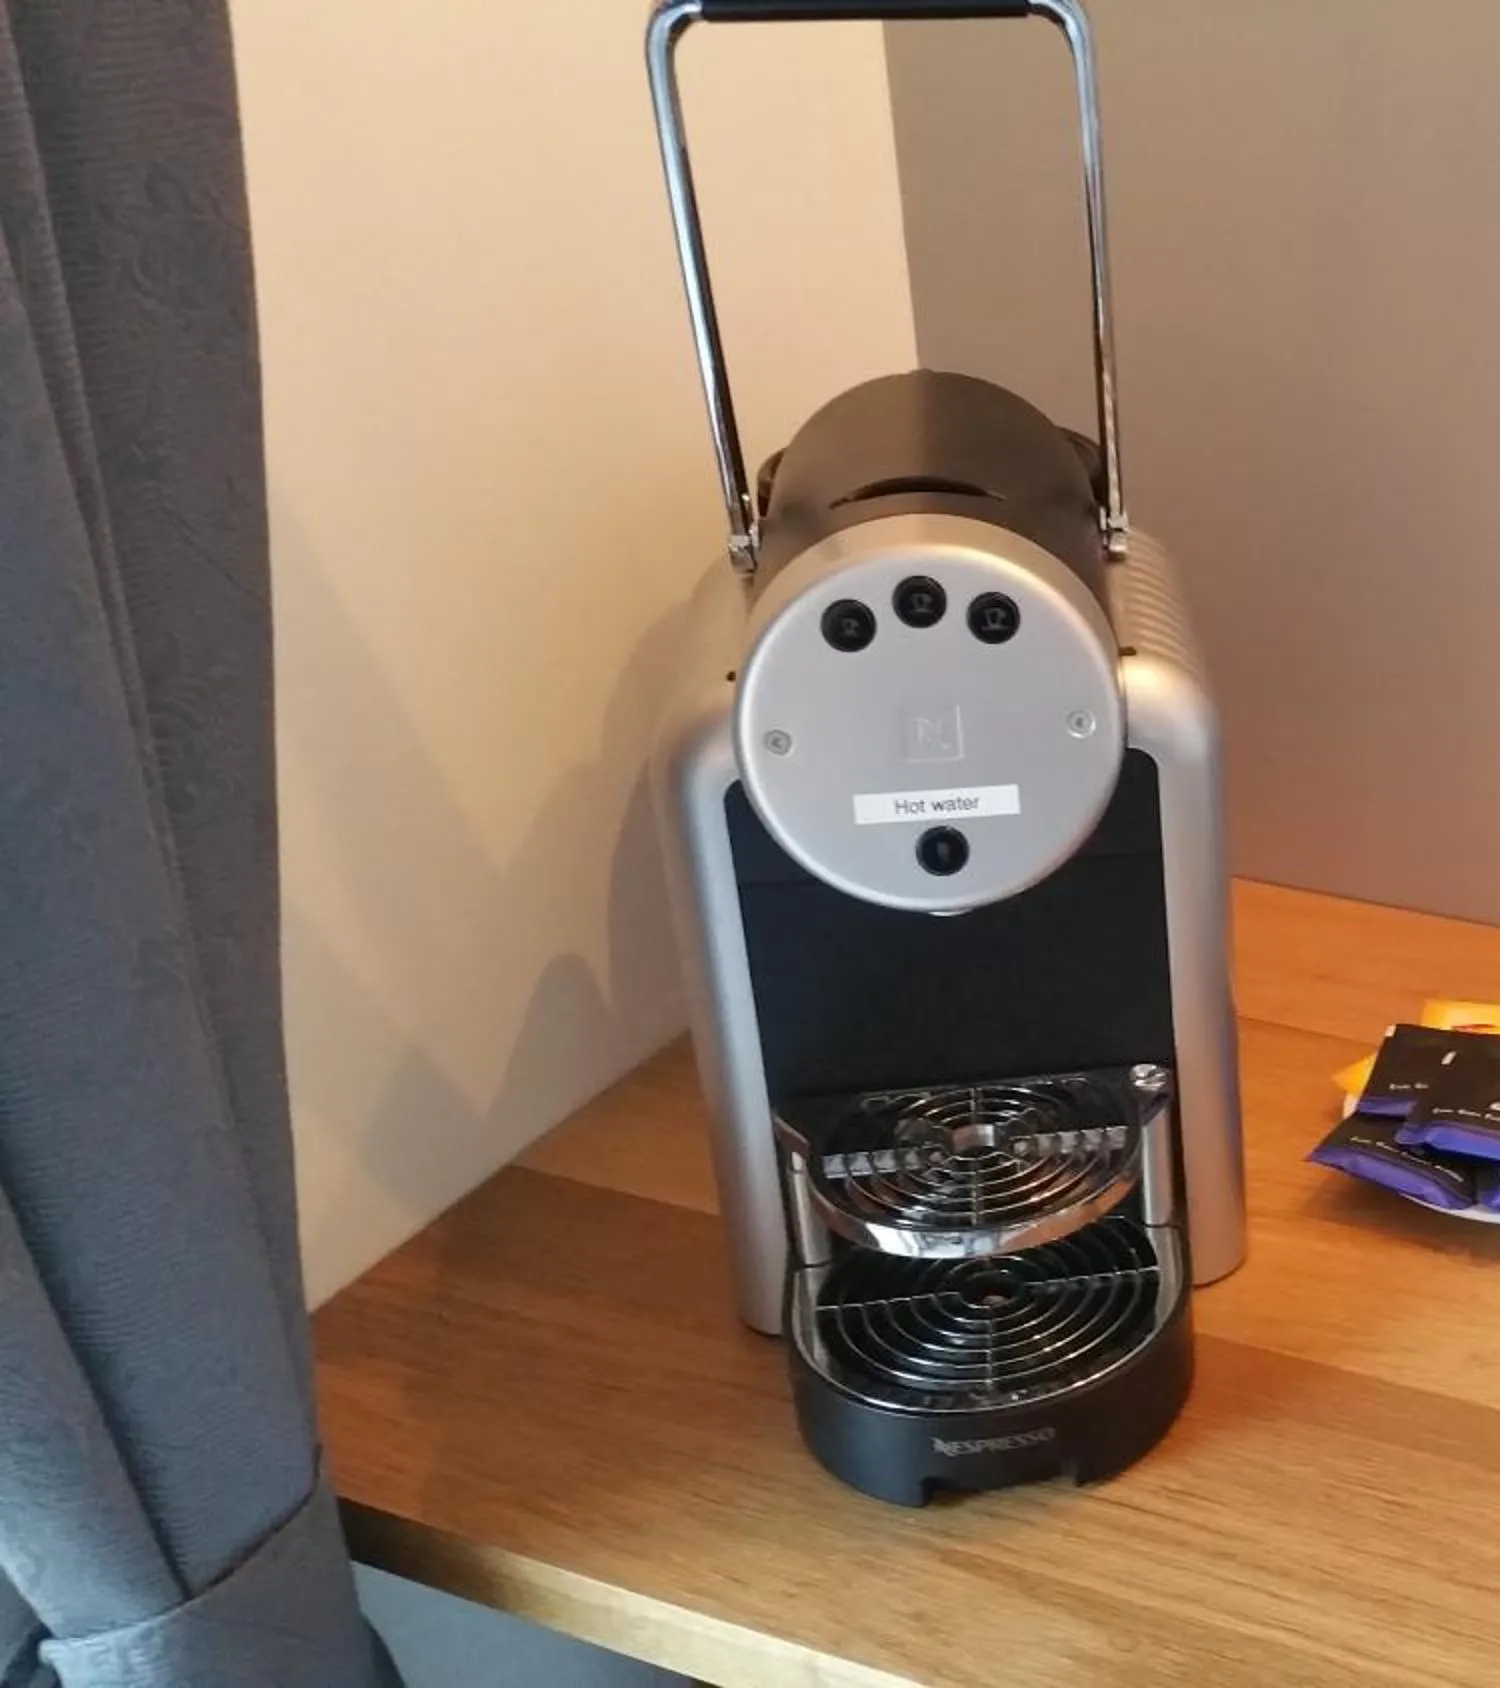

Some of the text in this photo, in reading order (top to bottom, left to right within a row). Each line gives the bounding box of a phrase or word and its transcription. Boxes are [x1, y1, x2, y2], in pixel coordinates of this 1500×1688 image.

[894, 796, 980, 815] Hot water
[930, 1427, 1056, 1458] NESPRESSO
